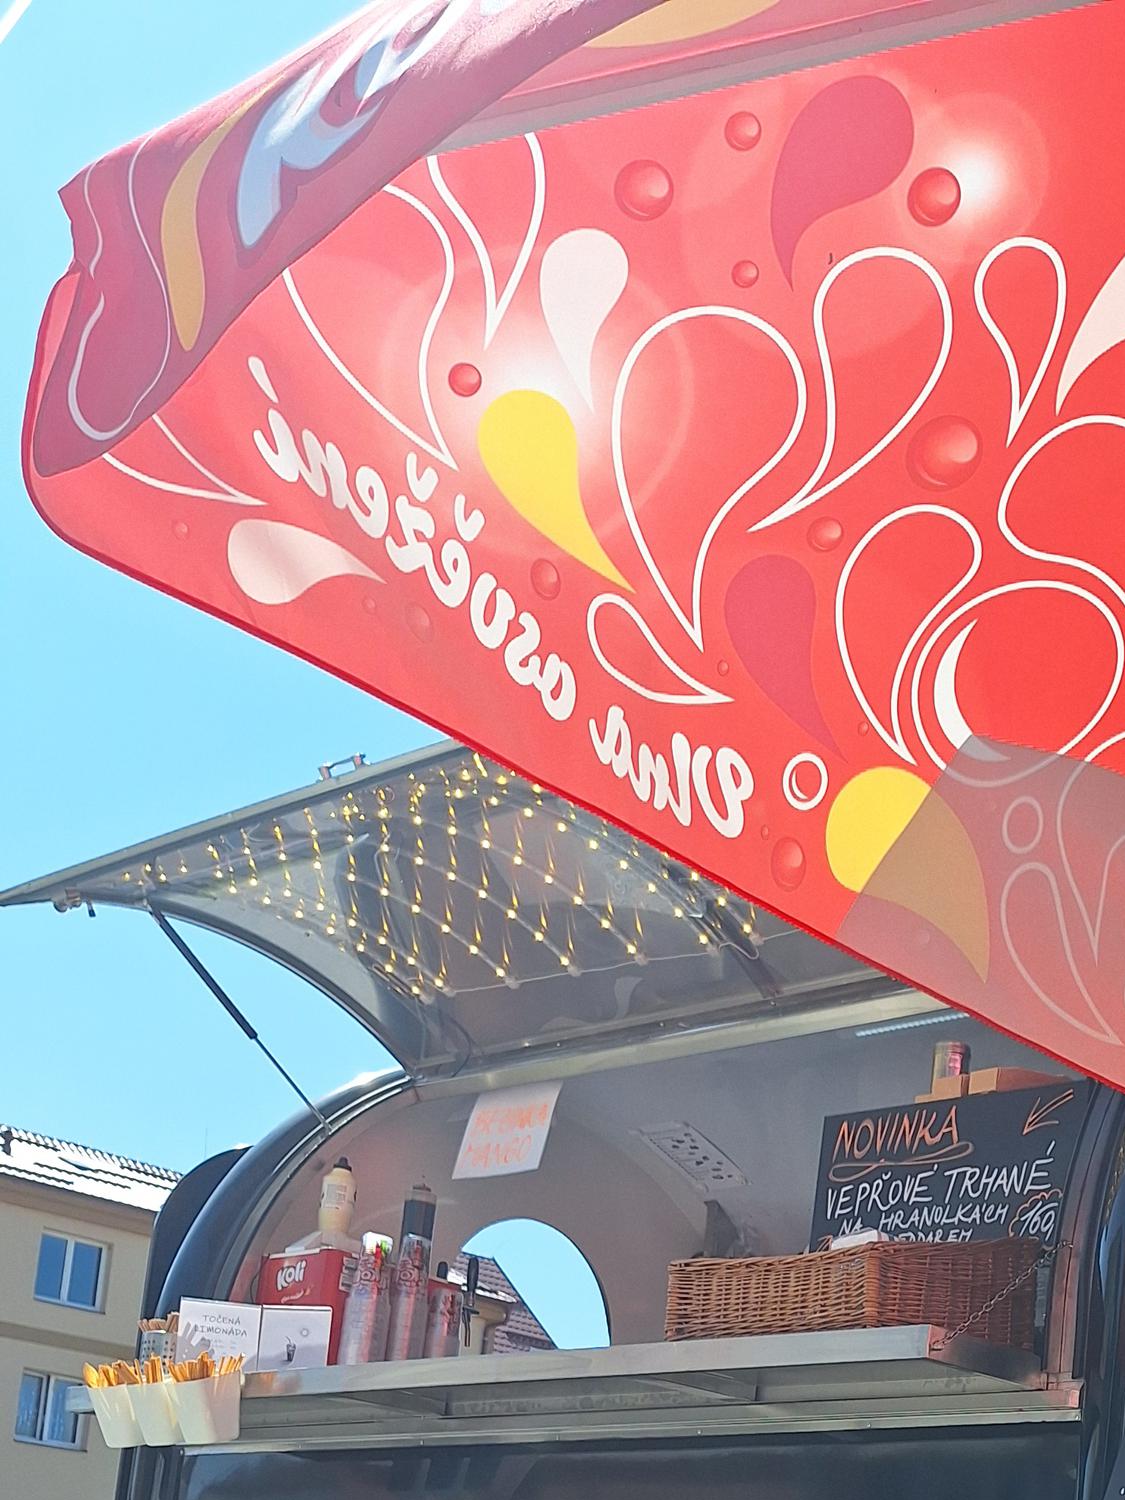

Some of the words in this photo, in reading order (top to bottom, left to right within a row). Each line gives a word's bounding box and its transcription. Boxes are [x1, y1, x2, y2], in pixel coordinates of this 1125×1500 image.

[832, 1105, 960, 1163] NOVINKA
[826, 1163, 938, 1220] VEPŘOVÉ
[943, 1140, 1056, 1204] TRHANÉ
[838, 1216, 864, 1237] NA
[878, 1202, 1010, 1232] HRANOLKÁCH
